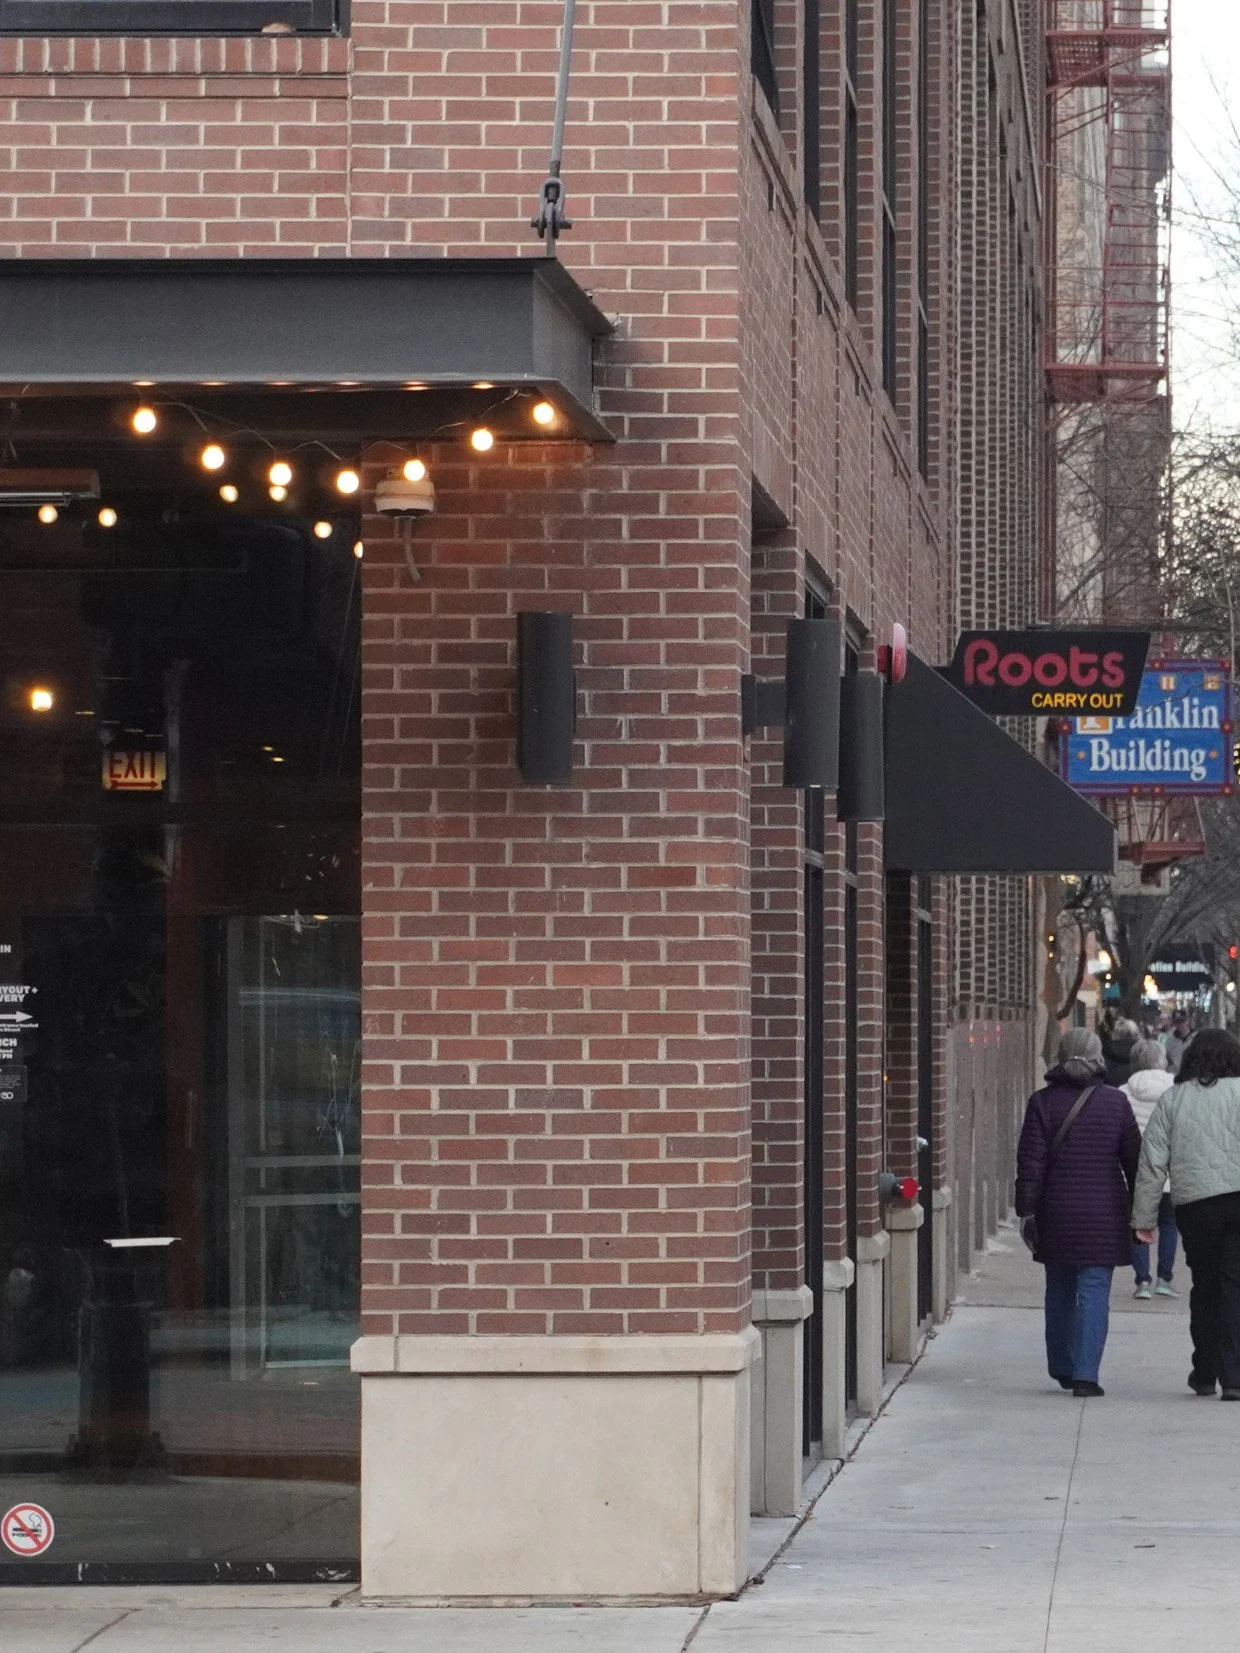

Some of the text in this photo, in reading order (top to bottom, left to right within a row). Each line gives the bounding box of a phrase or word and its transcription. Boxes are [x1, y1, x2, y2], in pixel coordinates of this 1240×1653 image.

[963, 639, 1125, 687] Roots
[1031, 692, 1124, 708] CARRY OUT
[109, 750, 156, 778] EXIT
[1089, 737, 1207, 782] Building
